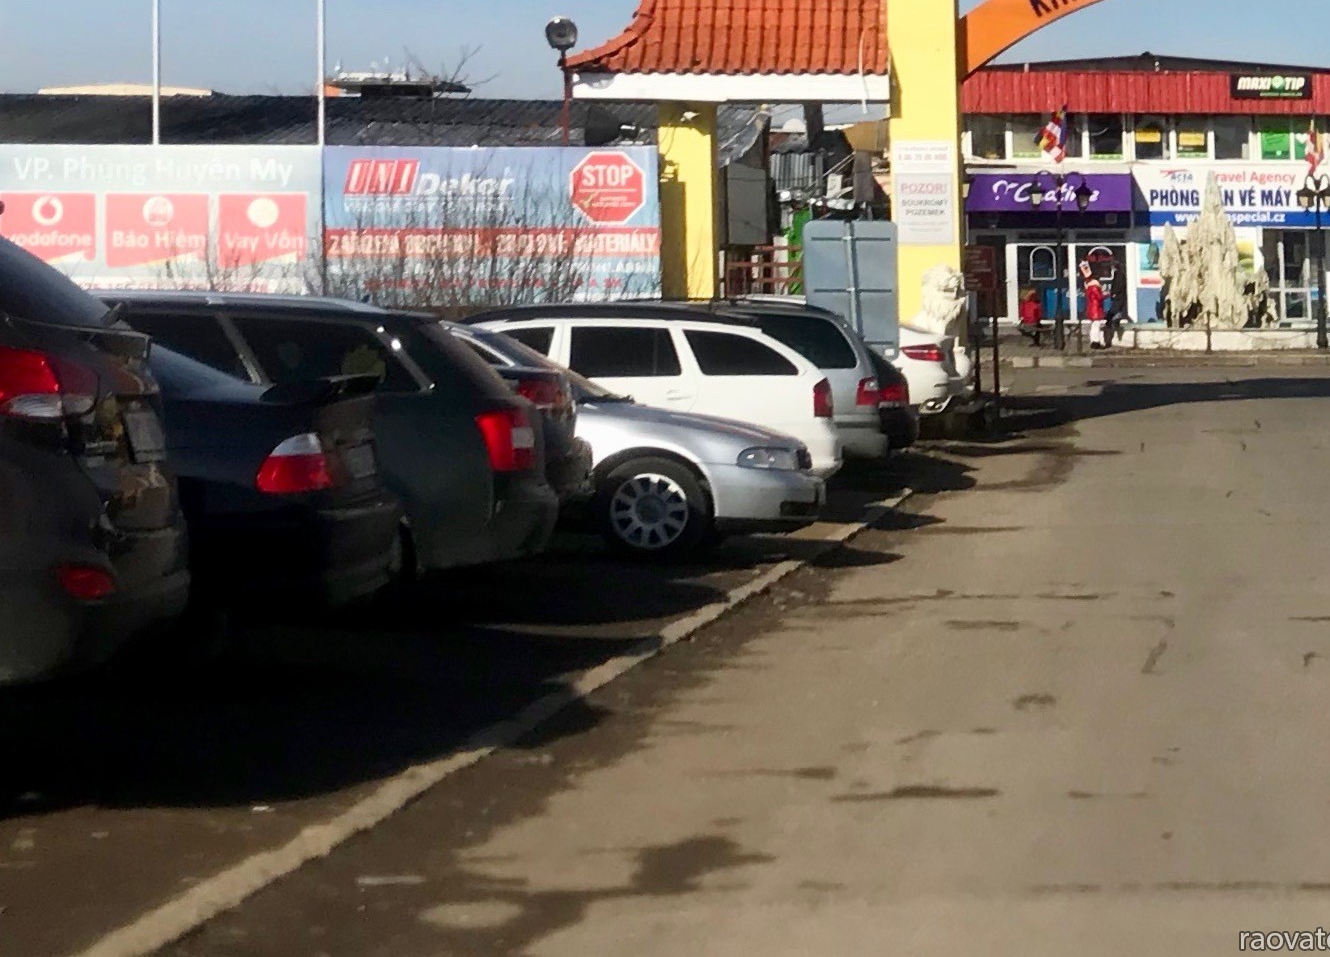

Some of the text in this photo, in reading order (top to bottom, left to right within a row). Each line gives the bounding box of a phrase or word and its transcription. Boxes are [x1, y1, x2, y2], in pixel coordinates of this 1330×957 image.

[1285, 76, 1305, 90] TIP
[582, 164, 634, 187] STOP
[1213, 171, 1296, 185] ravel Agency
